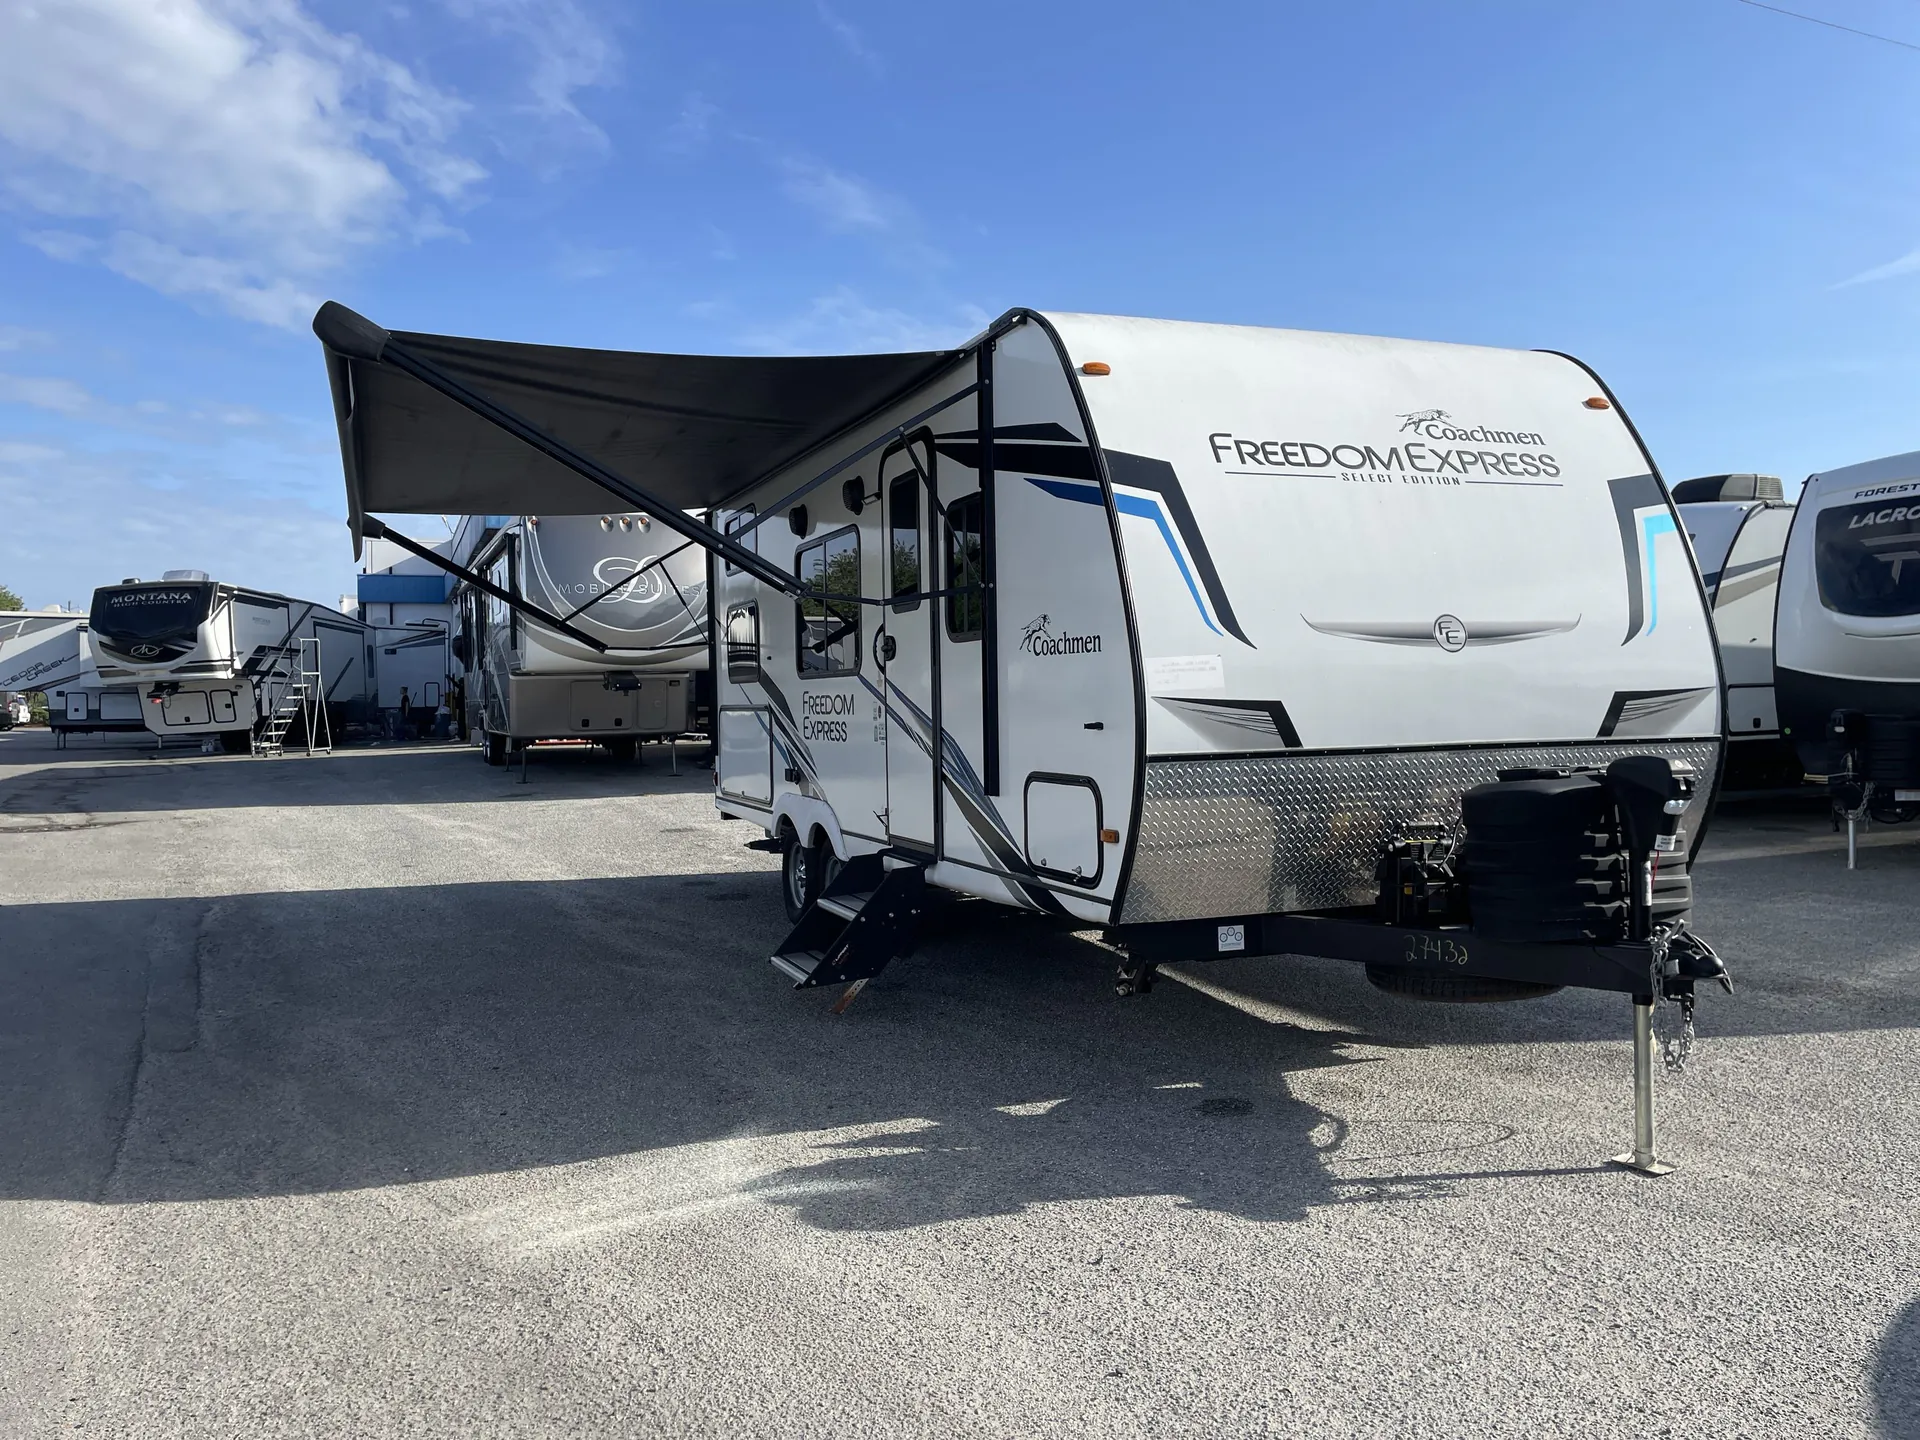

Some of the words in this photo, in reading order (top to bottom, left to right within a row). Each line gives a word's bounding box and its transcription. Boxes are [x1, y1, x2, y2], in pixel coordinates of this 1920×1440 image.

[1425, 424, 1547, 446] Coachmen
[1341, 472, 1393, 484] SELECT
[1402, 474, 1461, 486] EDITION
[1854, 483, 1920, 499] FOREST
[111, 592, 192, 604] MONTANA
[559, 583, 630, 594] MOBIE
[1032, 630, 1102, 657] Coachmen
[2, 661, 45, 687] CEDAR
[26, 657, 66, 681] CREEK
[802, 690, 855, 716] FREEDOM
[802, 715, 848, 743] EXPRESS
